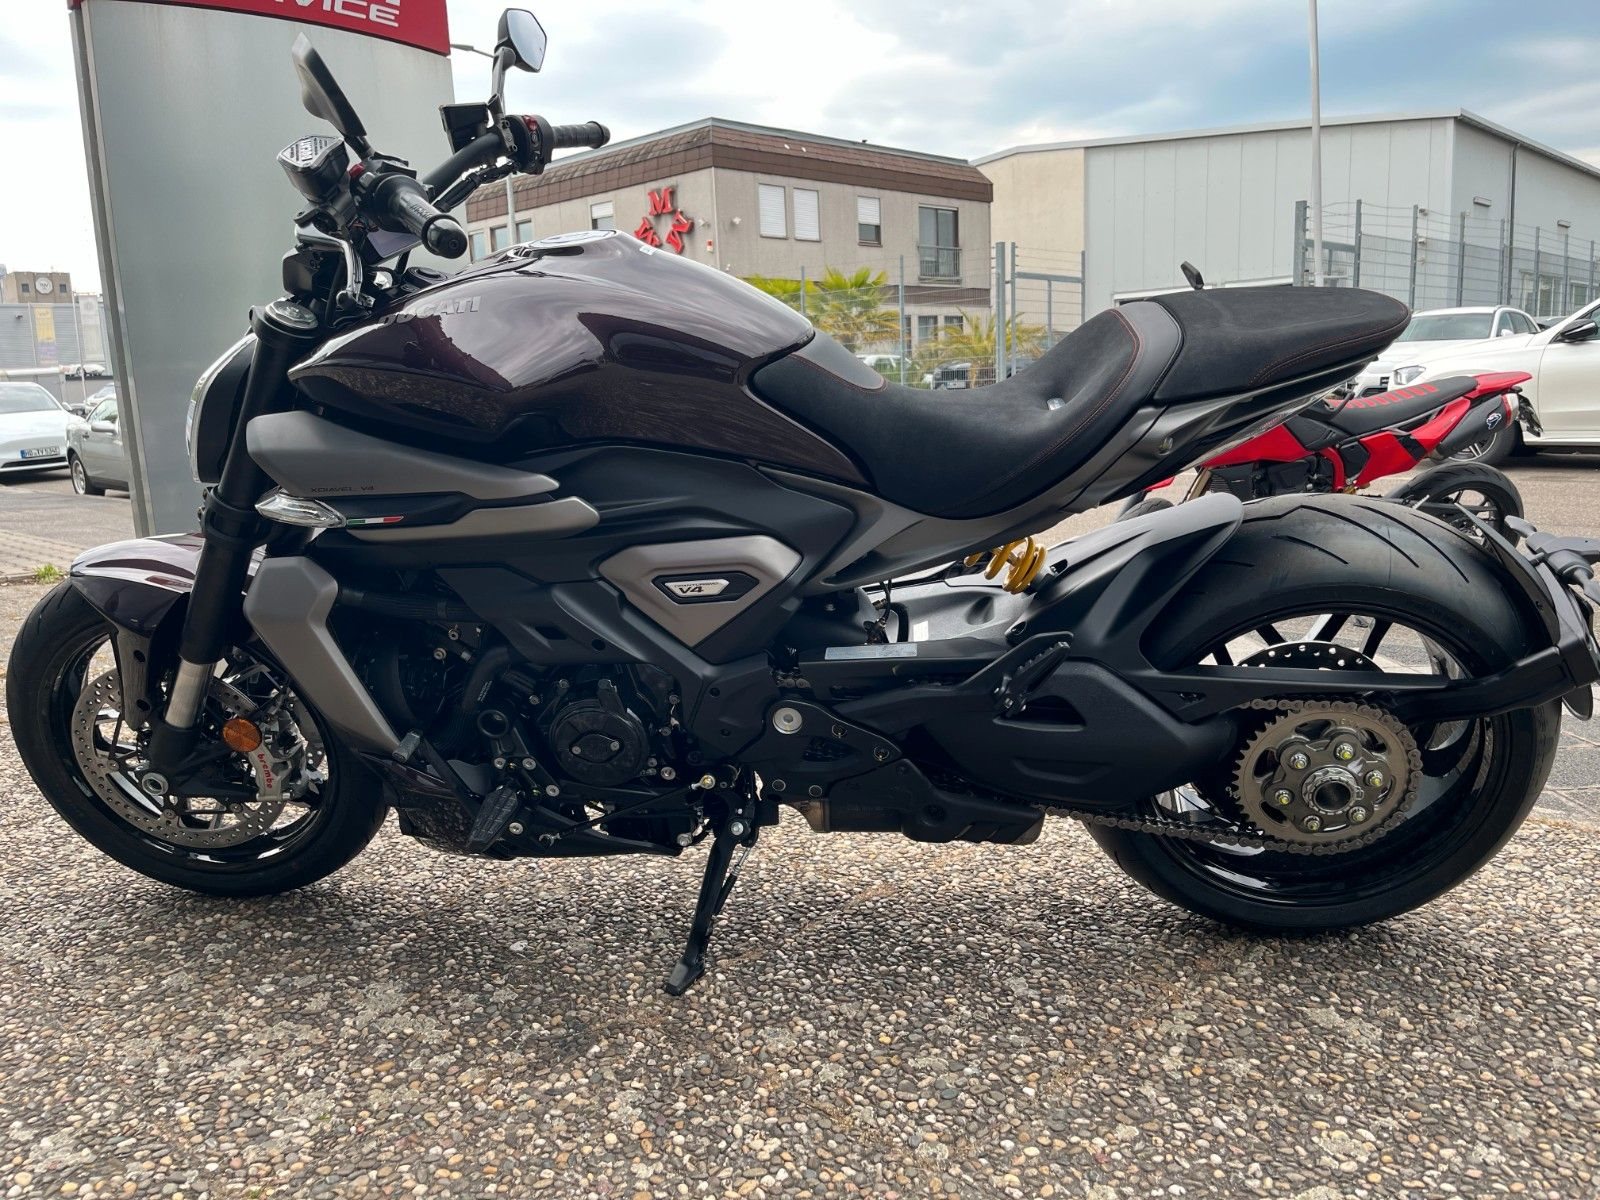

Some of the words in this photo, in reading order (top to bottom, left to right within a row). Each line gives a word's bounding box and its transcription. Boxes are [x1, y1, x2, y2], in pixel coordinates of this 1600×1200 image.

[647, 186, 675, 217] M
[378, 296, 481, 328] DUCATI
[678, 586, 704, 594] V4
[257, 752, 273, 789] brembo
